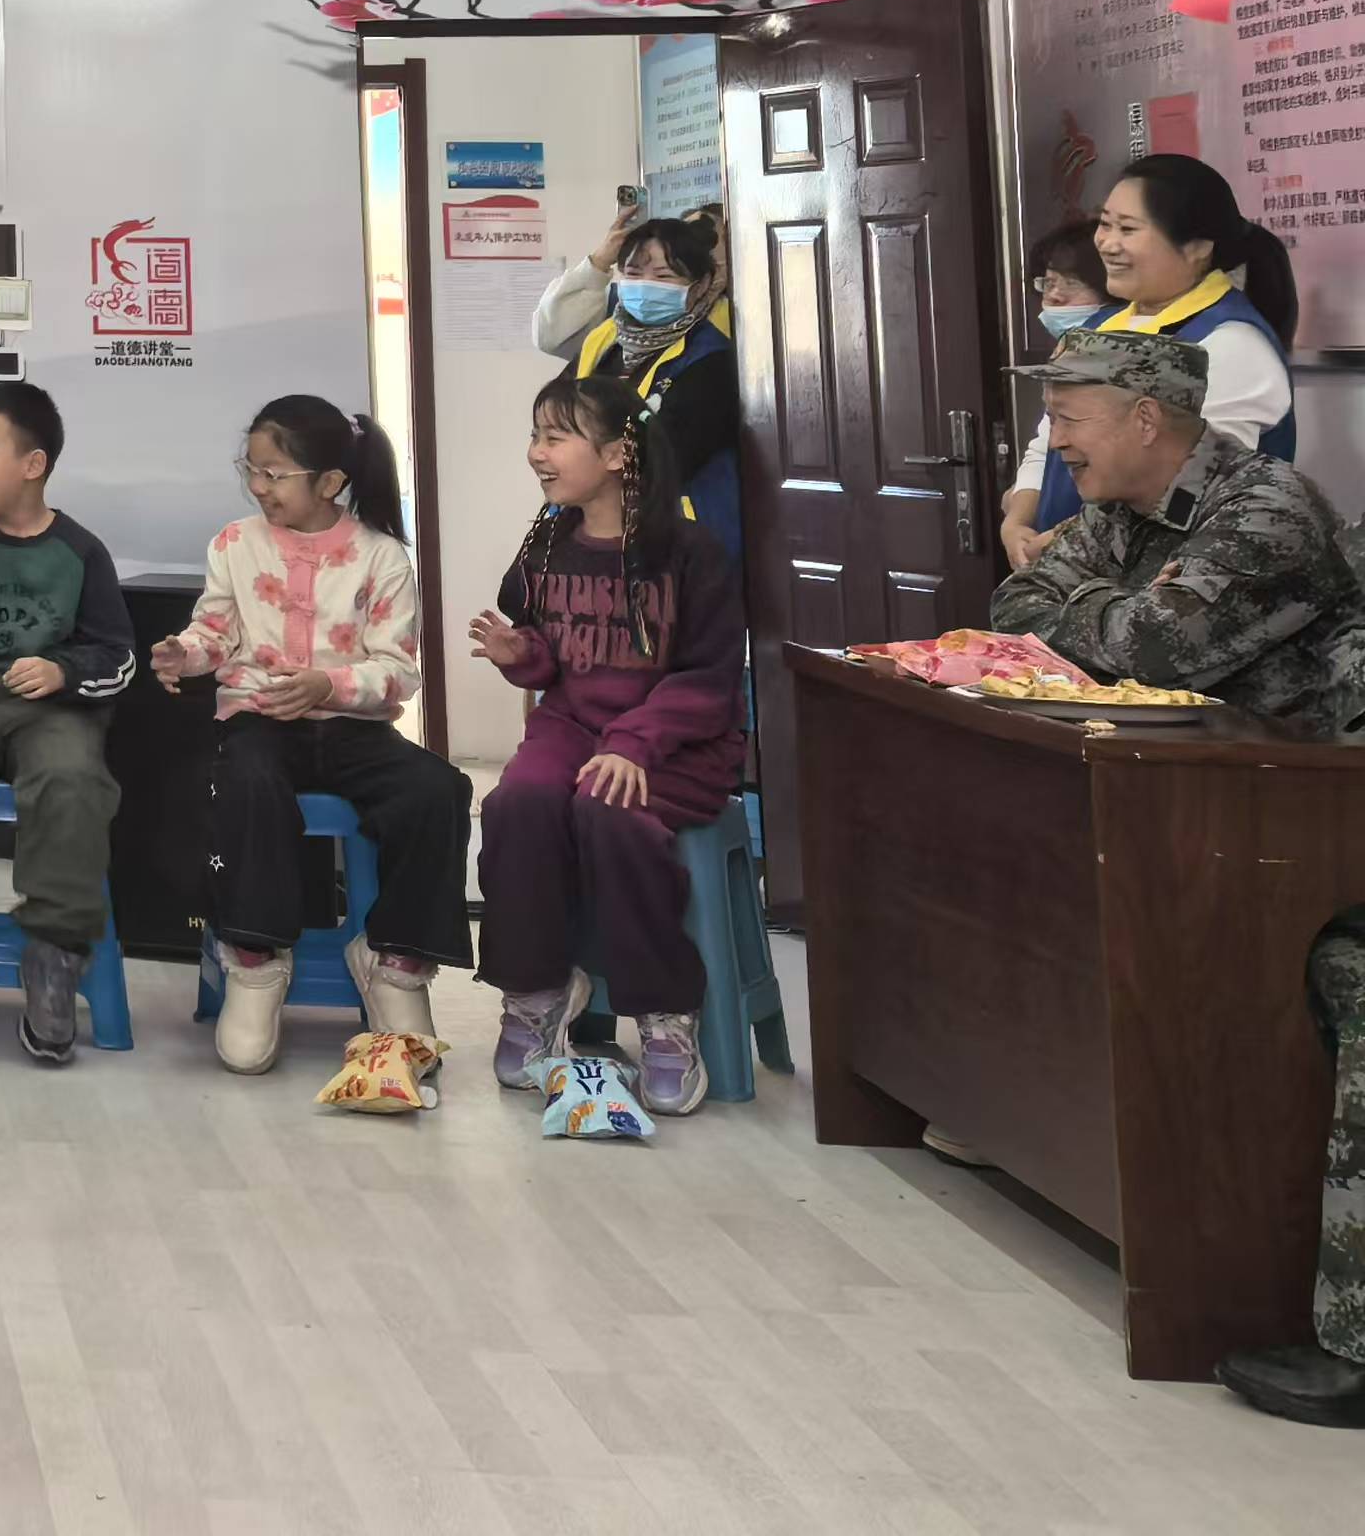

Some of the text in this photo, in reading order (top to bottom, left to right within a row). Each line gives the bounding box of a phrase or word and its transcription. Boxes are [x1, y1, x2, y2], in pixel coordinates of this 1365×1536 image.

[111, 340, 174, 357] 道德讲堂
[94, 357, 193, 368] DAODEJIANGTANG
